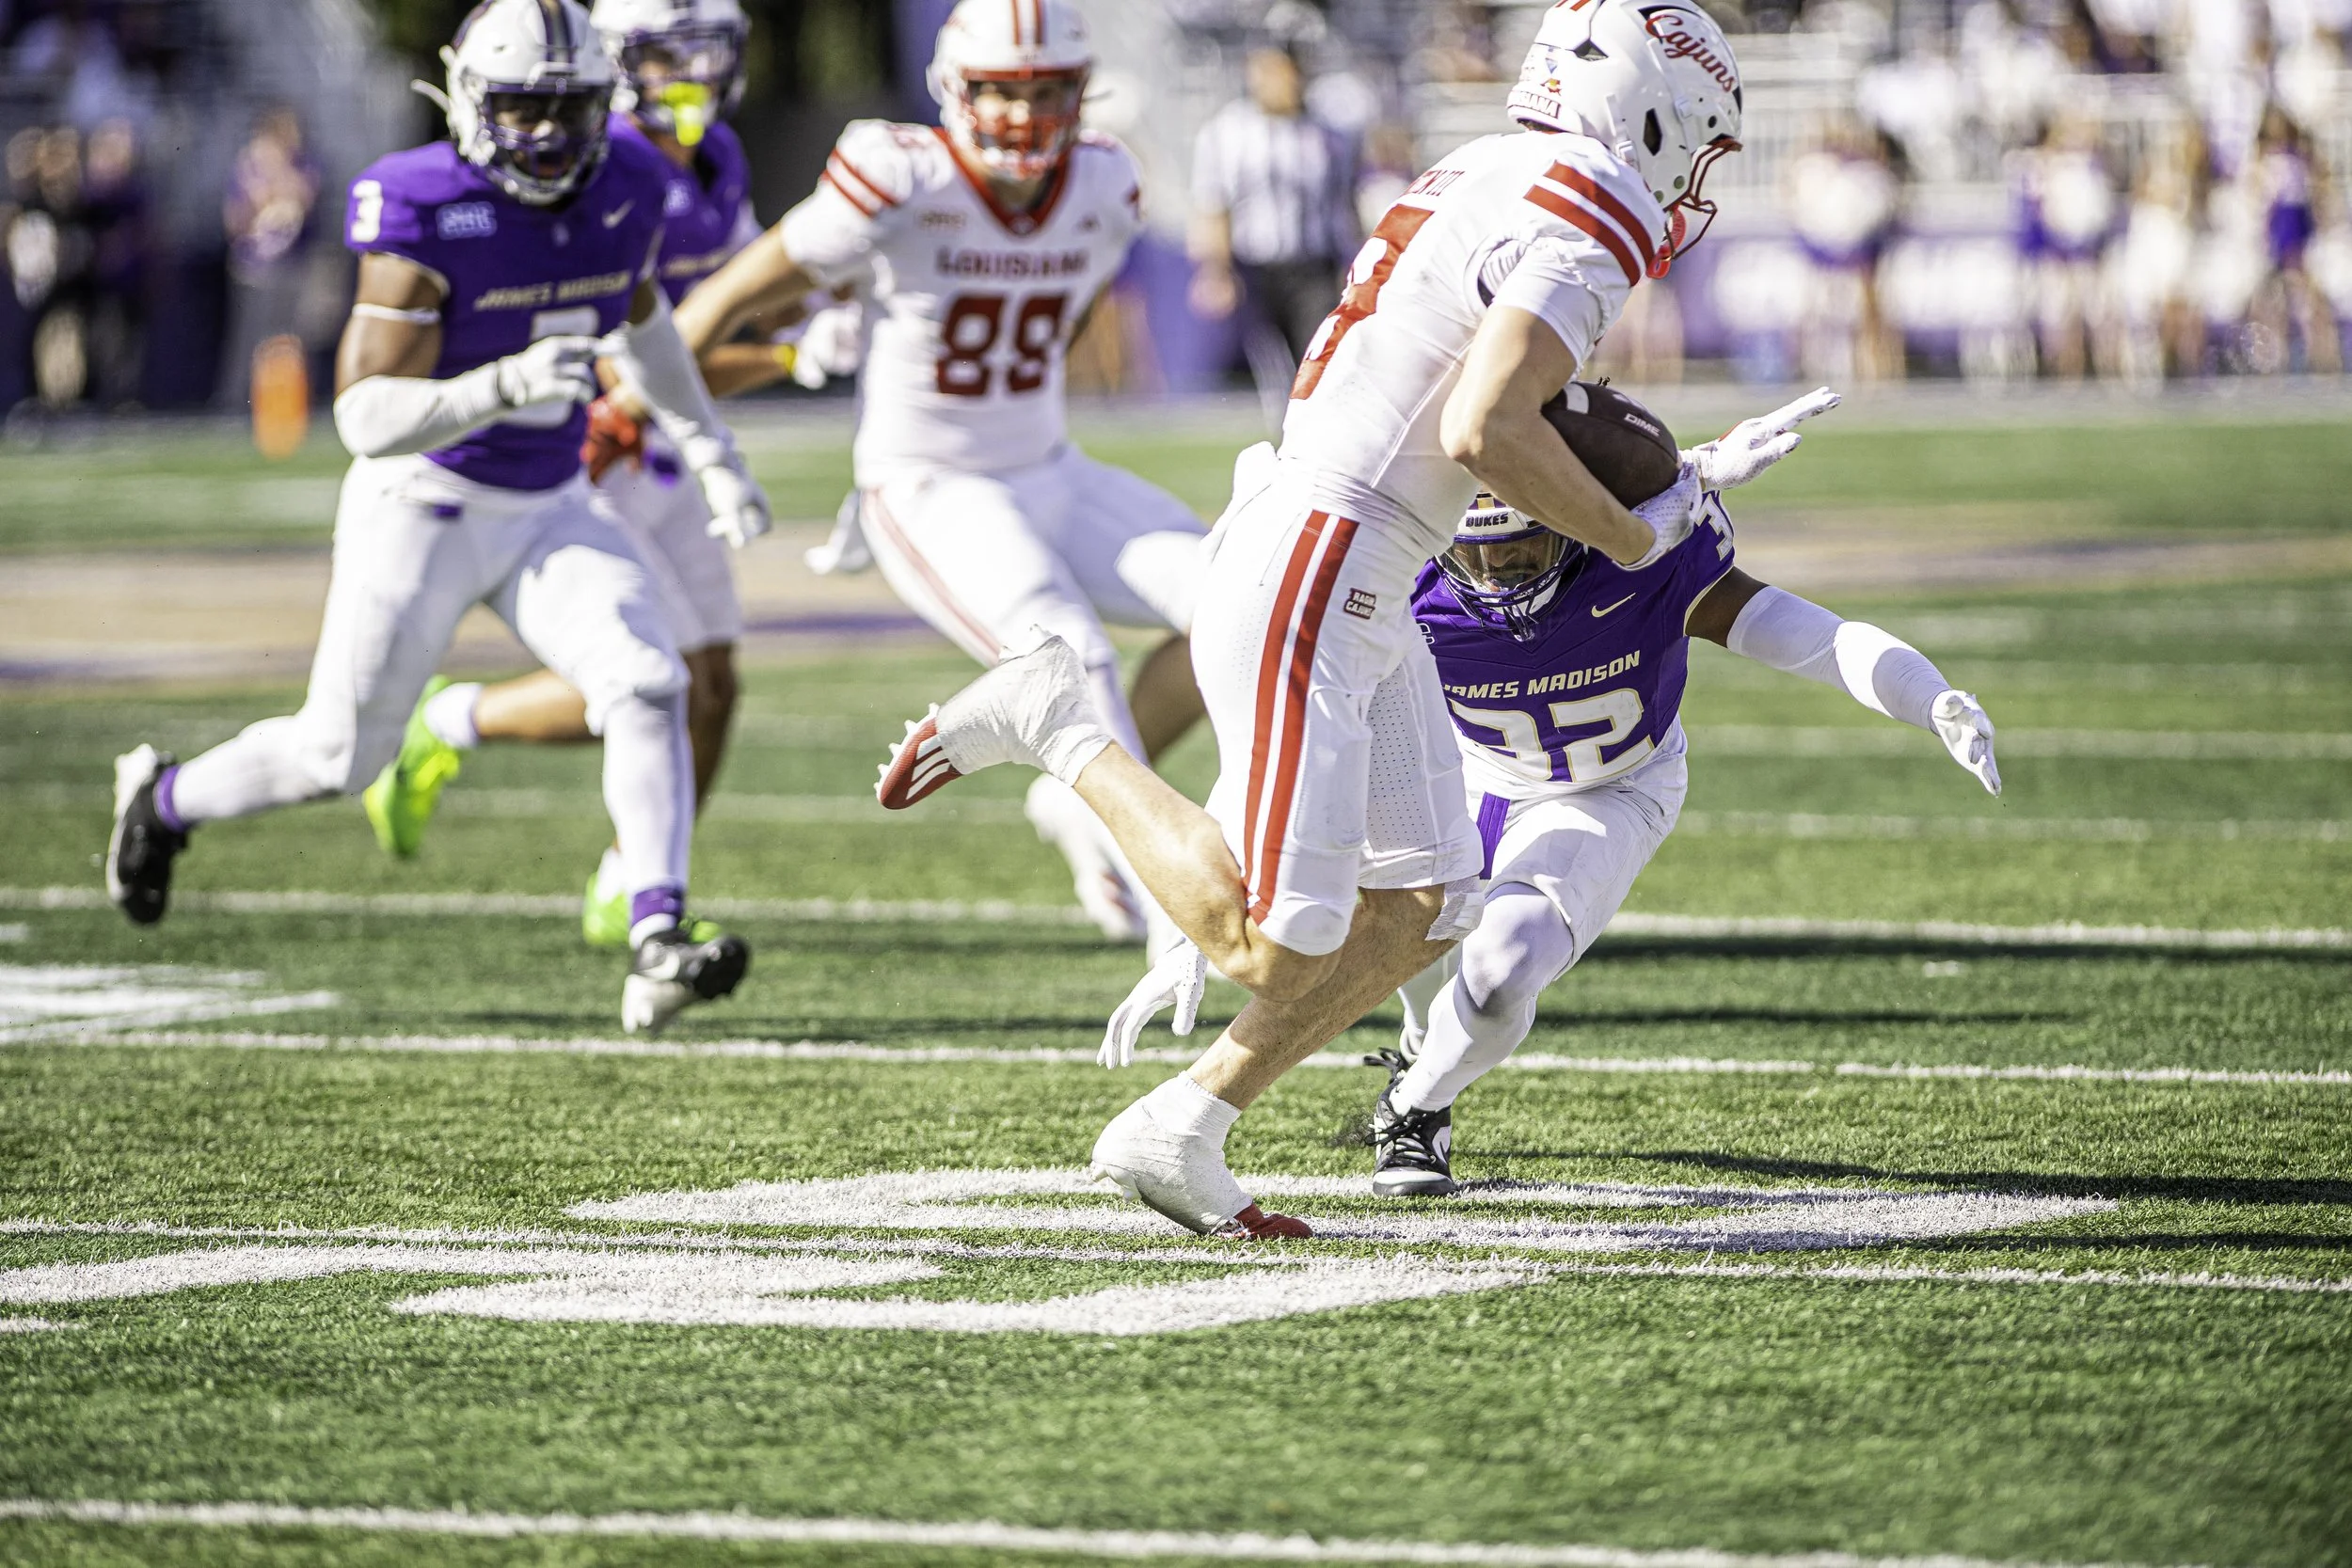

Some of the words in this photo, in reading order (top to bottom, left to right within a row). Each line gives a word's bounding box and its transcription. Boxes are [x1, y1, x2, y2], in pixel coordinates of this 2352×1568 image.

[1645, 14, 1737, 93] Cajuns
[352, 179, 383, 242] 3
[935, 293, 1067, 395] 89
[1624, 413, 1661, 437] DIME
[1465, 512, 1509, 528] DUKES
[1526, 650, 1641, 697] MADISON
[1448, 688, 1656, 783] 32
